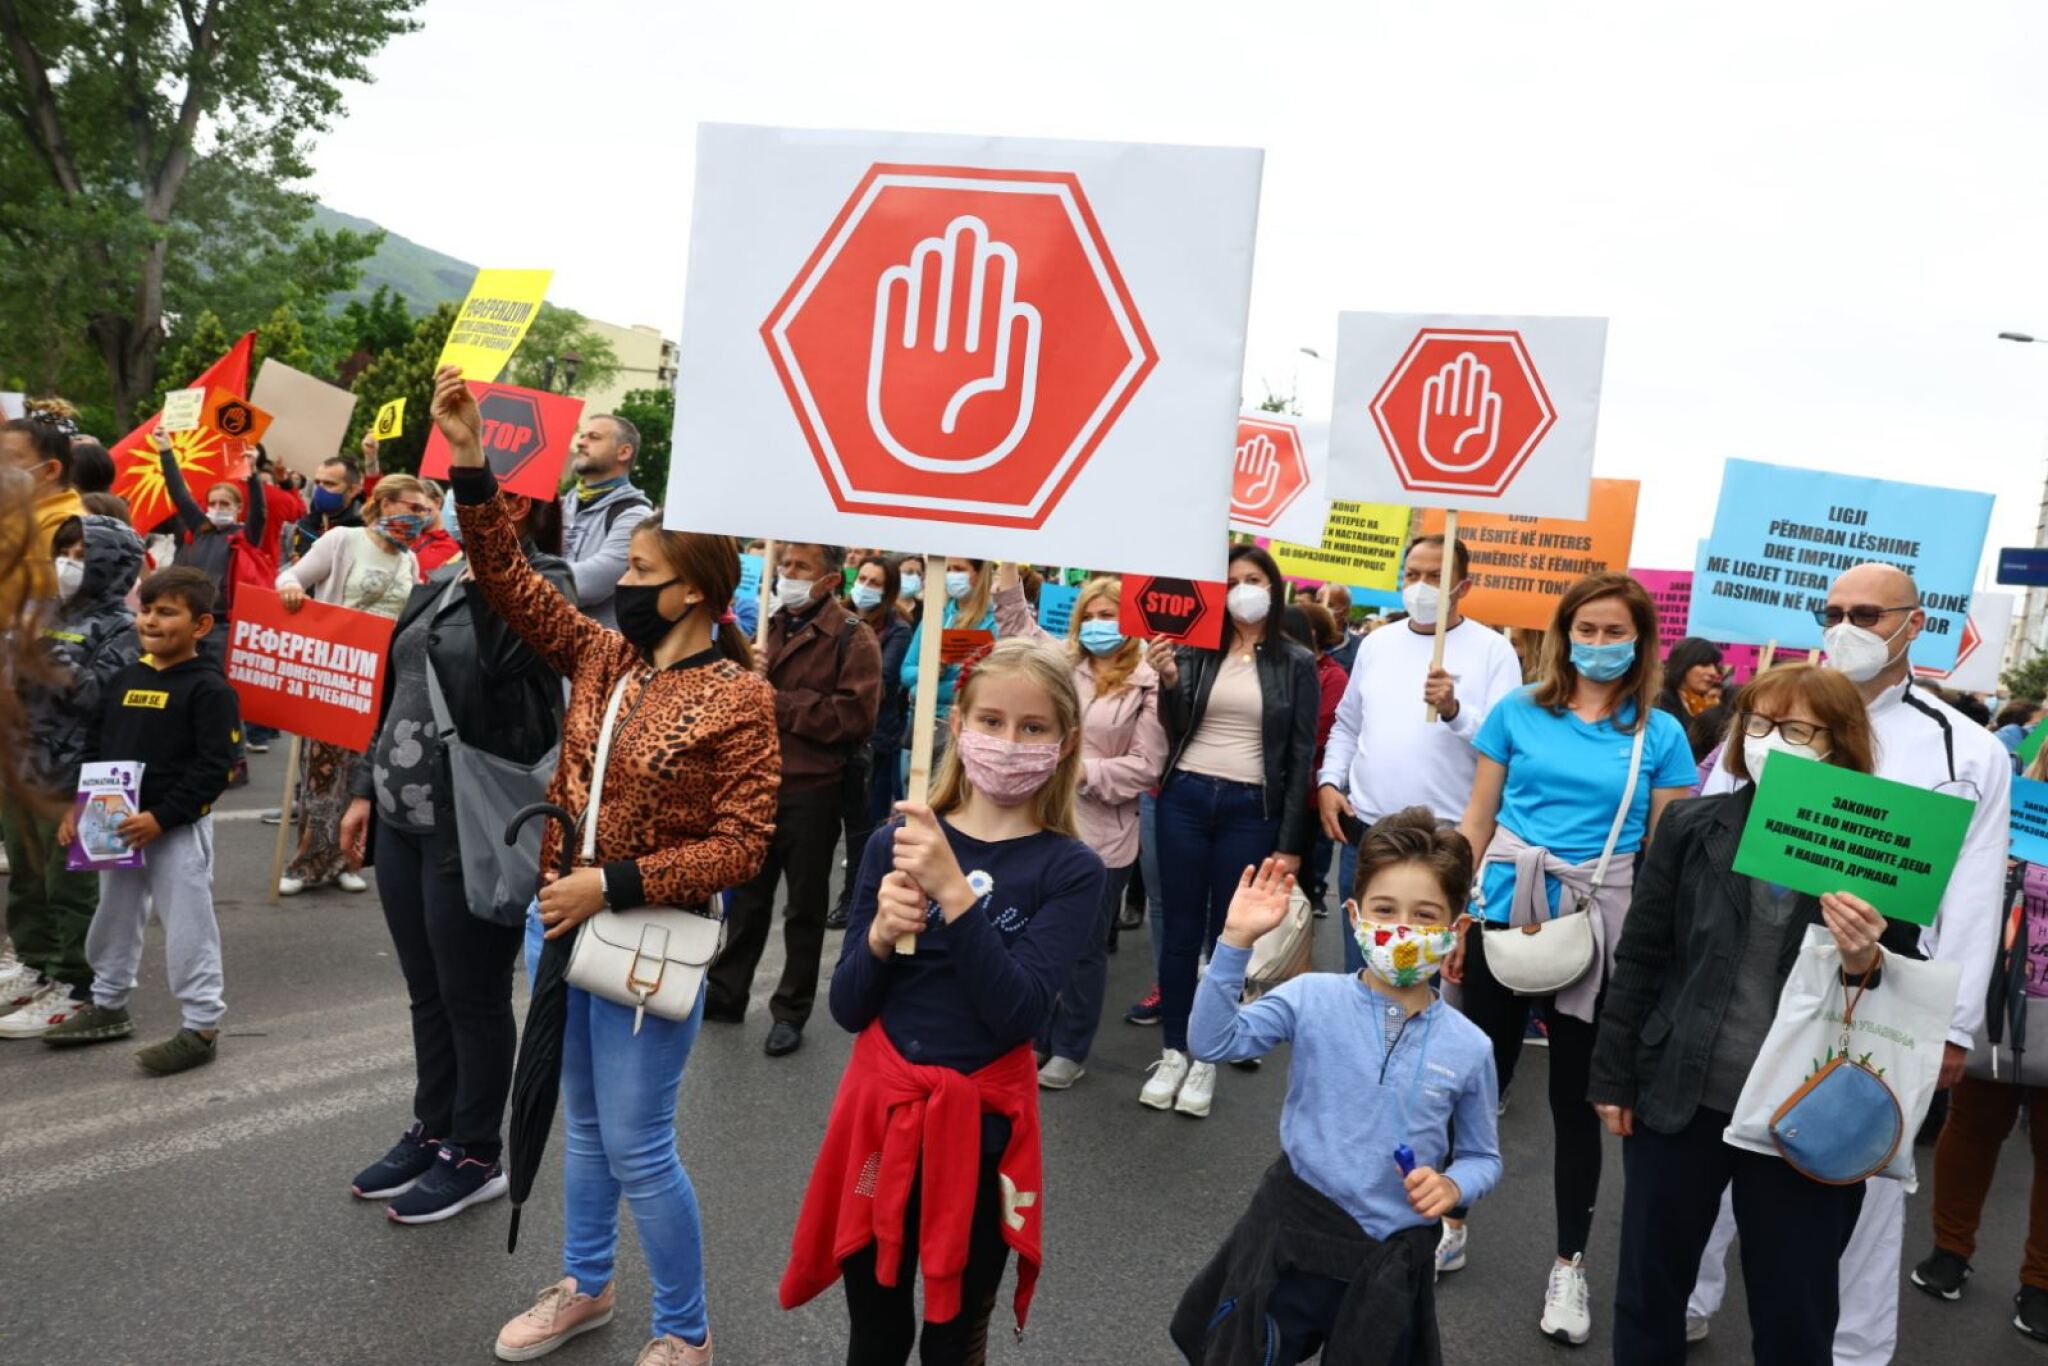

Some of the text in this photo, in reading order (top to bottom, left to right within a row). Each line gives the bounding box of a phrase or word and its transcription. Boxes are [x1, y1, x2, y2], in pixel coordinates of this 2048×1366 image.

[482, 418, 532, 453] TOP
[1367, 519, 1379, 529] НА
[1828, 505, 1868, 526] LIGJI
[1480, 525, 1518, 545] ËSHTË
[1520, 529, 1538, 547] NË
[1538, 533, 1592, 551] INTERES
[1763, 542, 1795, 562] DHE
[1768, 519, 1921, 558] PËRMBAN LËSHIME
[1352, 557, 1386, 572] ПРОЦЕС
[1529, 553, 1548, 571] SË
[1706, 556, 1729, 573] ME
[1732, 562, 1782, 585] LIGJET
[1783, 570, 1828, 591] TJERA
[1483, 574, 1536, 593] SHTETIT
[1712, 580, 1781, 606] ARSIMIN
[1782, 590, 1805, 611] NË
[1146, 591, 1196, 617] STOP
[233, 620, 378, 680] РЕФЕРЕНДУМ
[229, 663, 373, 714] ЗАКОНОТ ЗА УЧЕБНИЦИ
[277, 660, 357, 693] ДОНЕСУВАЊЕ
[357, 681, 373, 697] НА
[1832, 796, 1889, 822] ЗАКОНОТ
[1797, 808, 1912, 849] НЕ Е ВО ИНТЕРЕС НА
[1764, 818, 1932, 875] ИДНИНАТА НА НАШИТЕ ДЕЦА
[1784, 844, 1898, 887] И НАШАТА ДРЖАВА
